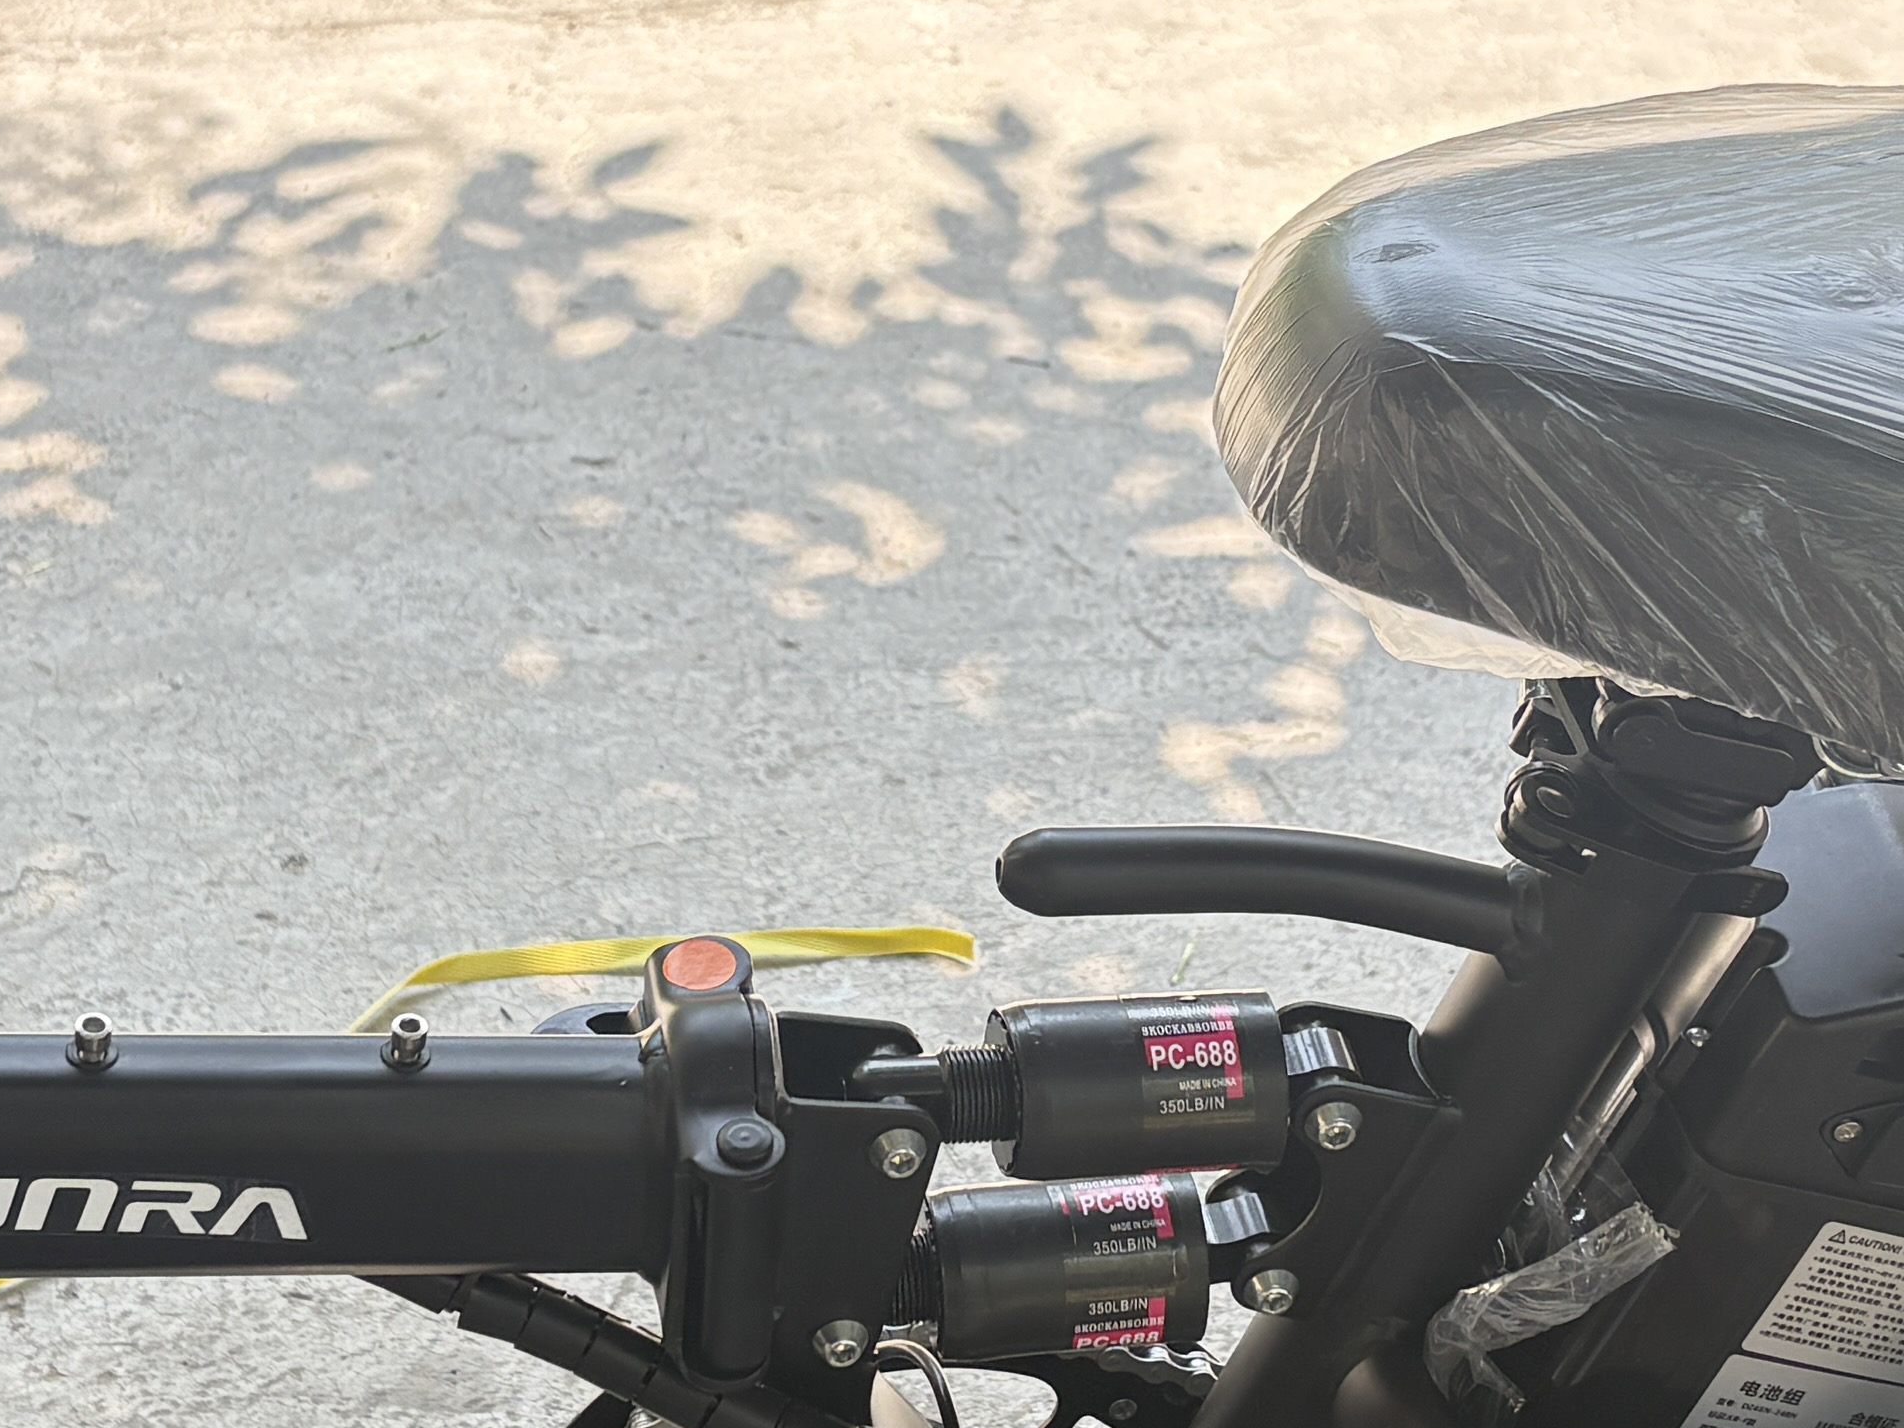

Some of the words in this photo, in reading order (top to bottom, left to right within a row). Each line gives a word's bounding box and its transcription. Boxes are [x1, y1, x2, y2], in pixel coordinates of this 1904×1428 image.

[1149, 1039, 1237, 1072] PC-688
[1178, 1078, 1202, 1091] MADE
[1159, 1096, 1226, 1115] 350LB/IN
[1078, 1188, 1165, 1216] PC-688
[1093, 1235, 1157, 1256] 350LB/IN
[1848, 1235, 1903, 1255] CAUTION!
[1088, 1297, 1149, 1316] 350LB/IN
[1076, 1331, 1160, 1350] PC-688
[1739, 1379, 1807, 1407] 电池组
